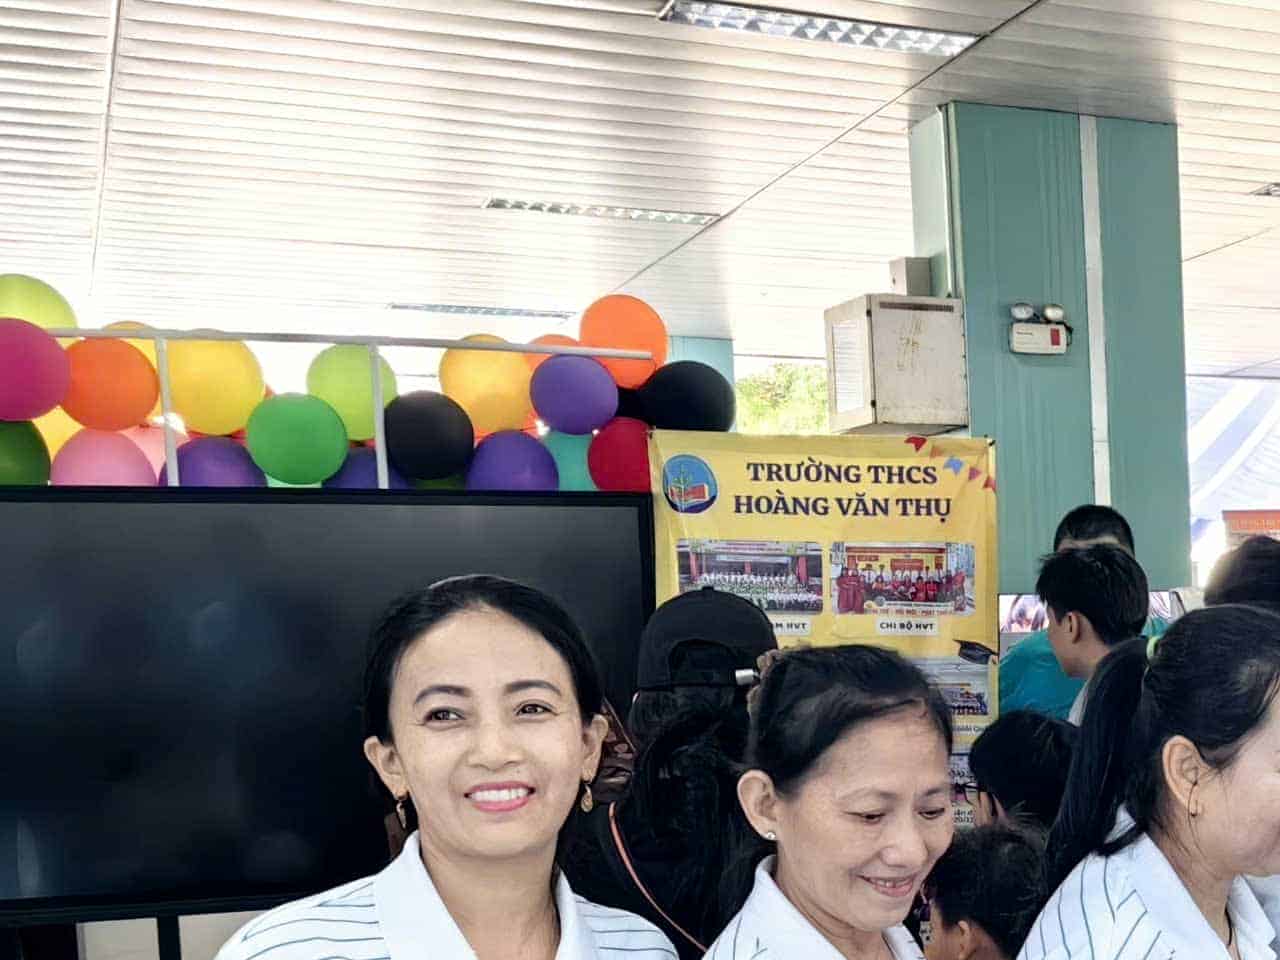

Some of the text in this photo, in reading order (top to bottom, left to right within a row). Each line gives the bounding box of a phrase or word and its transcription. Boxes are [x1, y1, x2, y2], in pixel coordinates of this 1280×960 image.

[747, 457, 937, 484] TRƯỜNG THCS
[734, 489, 951, 522] HOÀNG VĂN THỤ
[880, 620, 934, 631] CHI BỘ HVT
